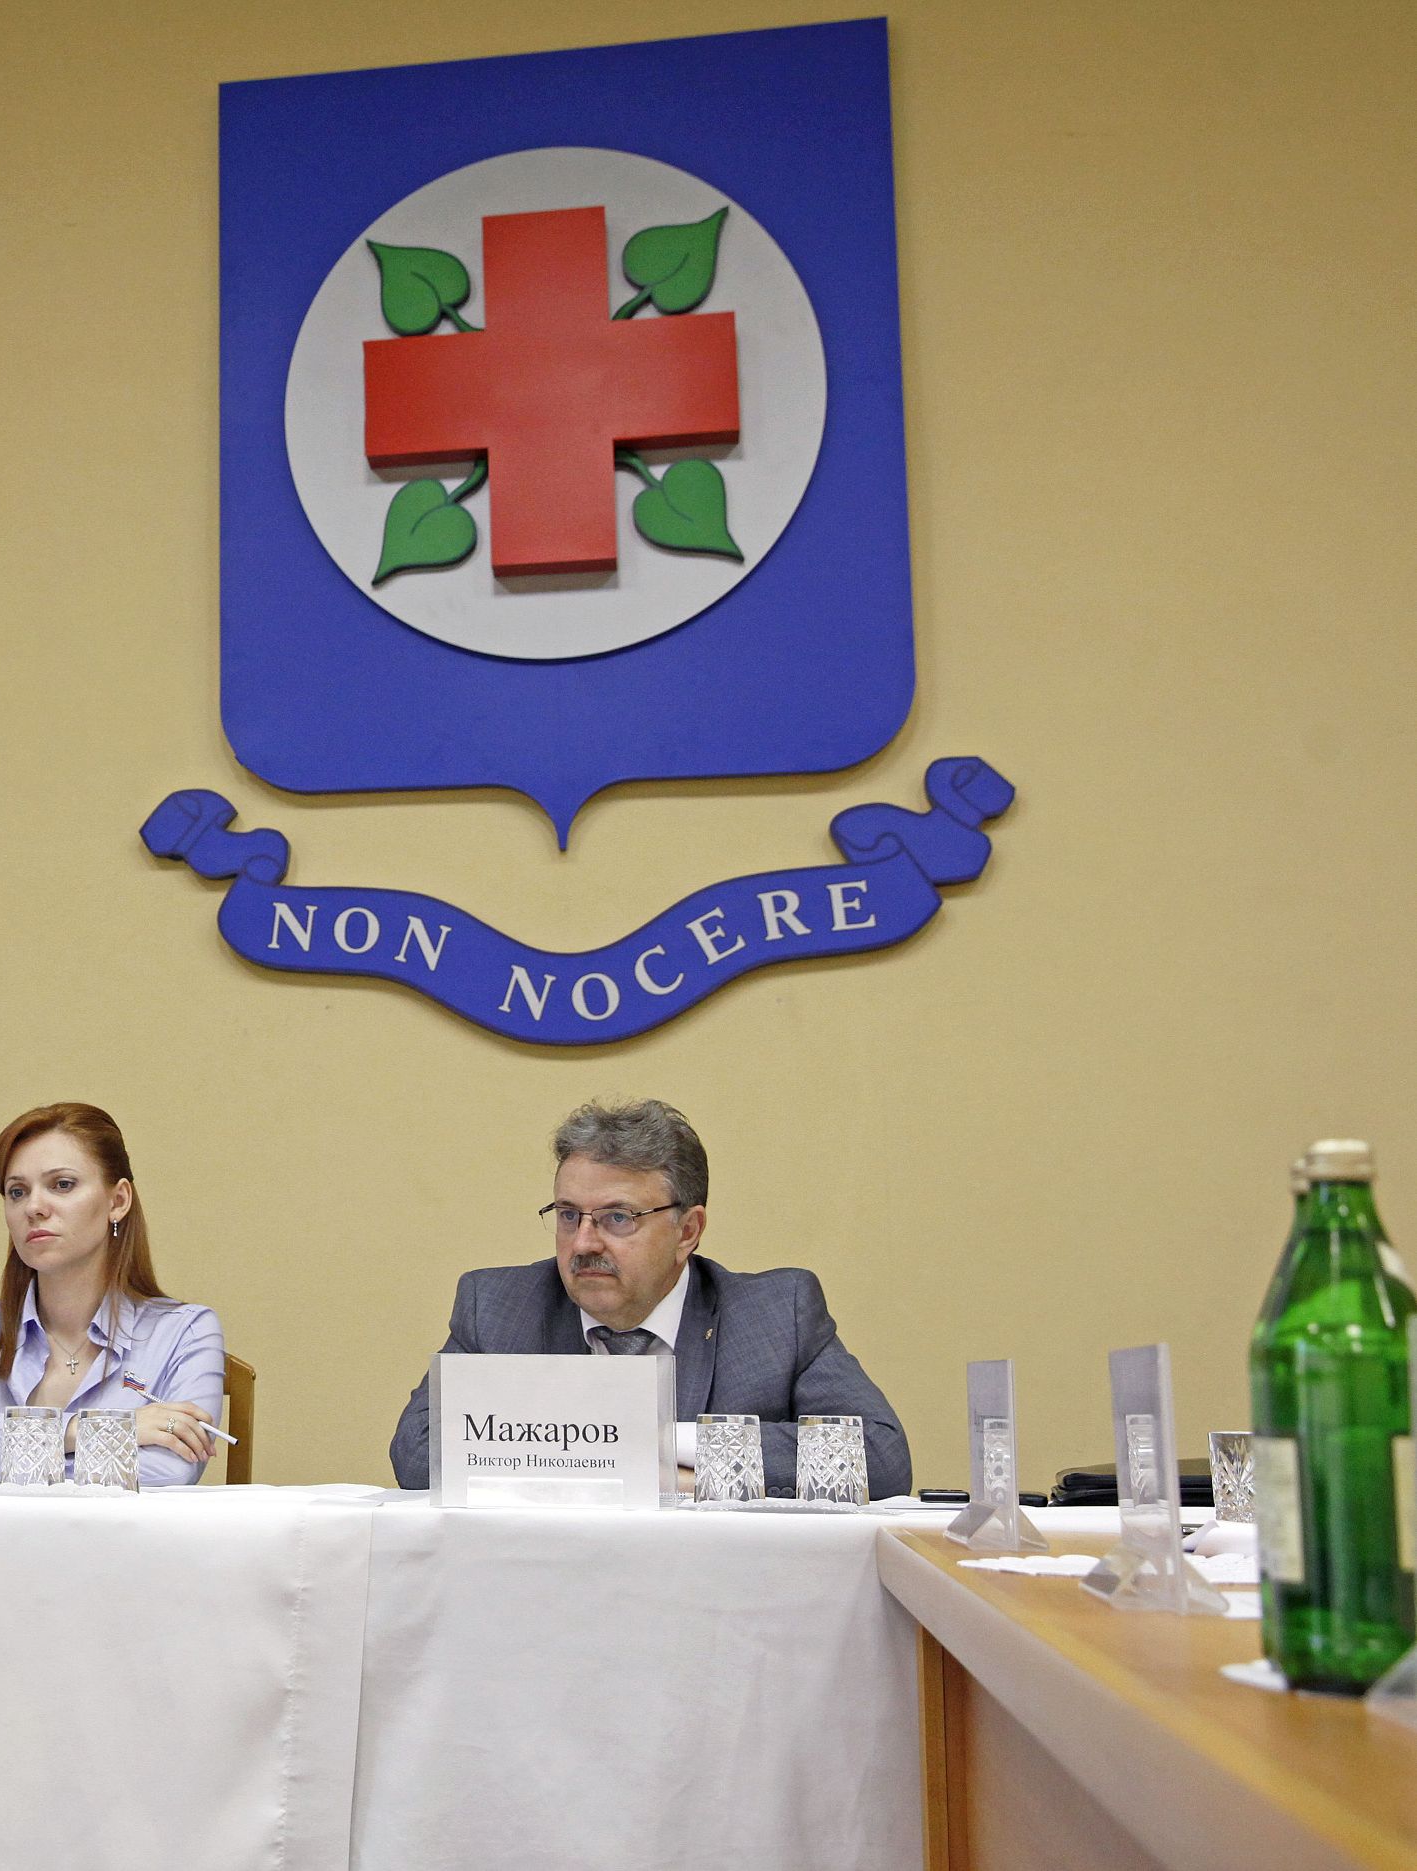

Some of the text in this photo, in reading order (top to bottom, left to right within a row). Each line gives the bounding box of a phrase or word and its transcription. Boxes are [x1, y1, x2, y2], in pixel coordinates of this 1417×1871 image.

[269, 880, 877, 1021] NON NOCERE
[463, 1413, 620, 1452] Мажаров
[466, 1453, 616, 1471] Виктор Николаевич
